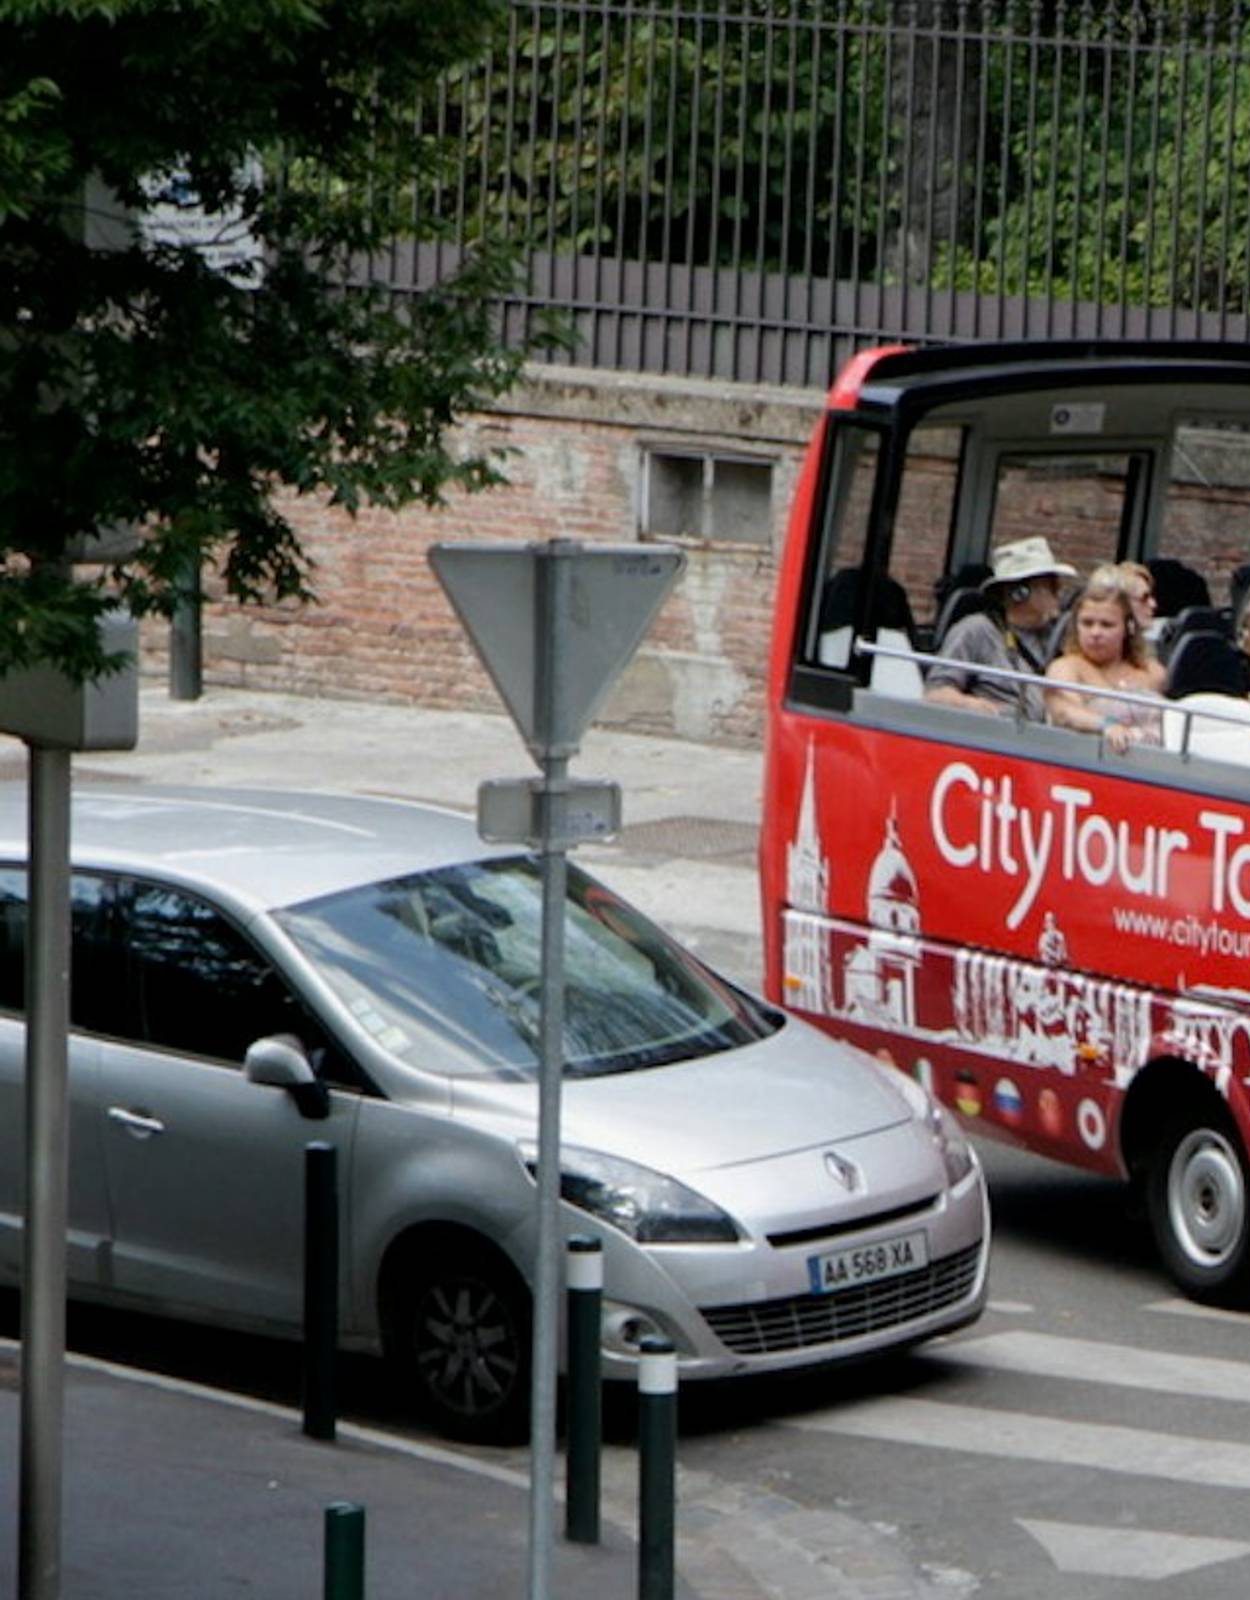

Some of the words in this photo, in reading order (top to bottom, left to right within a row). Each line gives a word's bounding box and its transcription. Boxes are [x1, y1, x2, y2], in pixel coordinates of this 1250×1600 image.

[825, 1258, 848, 1284] AA
[852, 1246, 887, 1278] 568
[890, 1240, 914, 1268] XA
